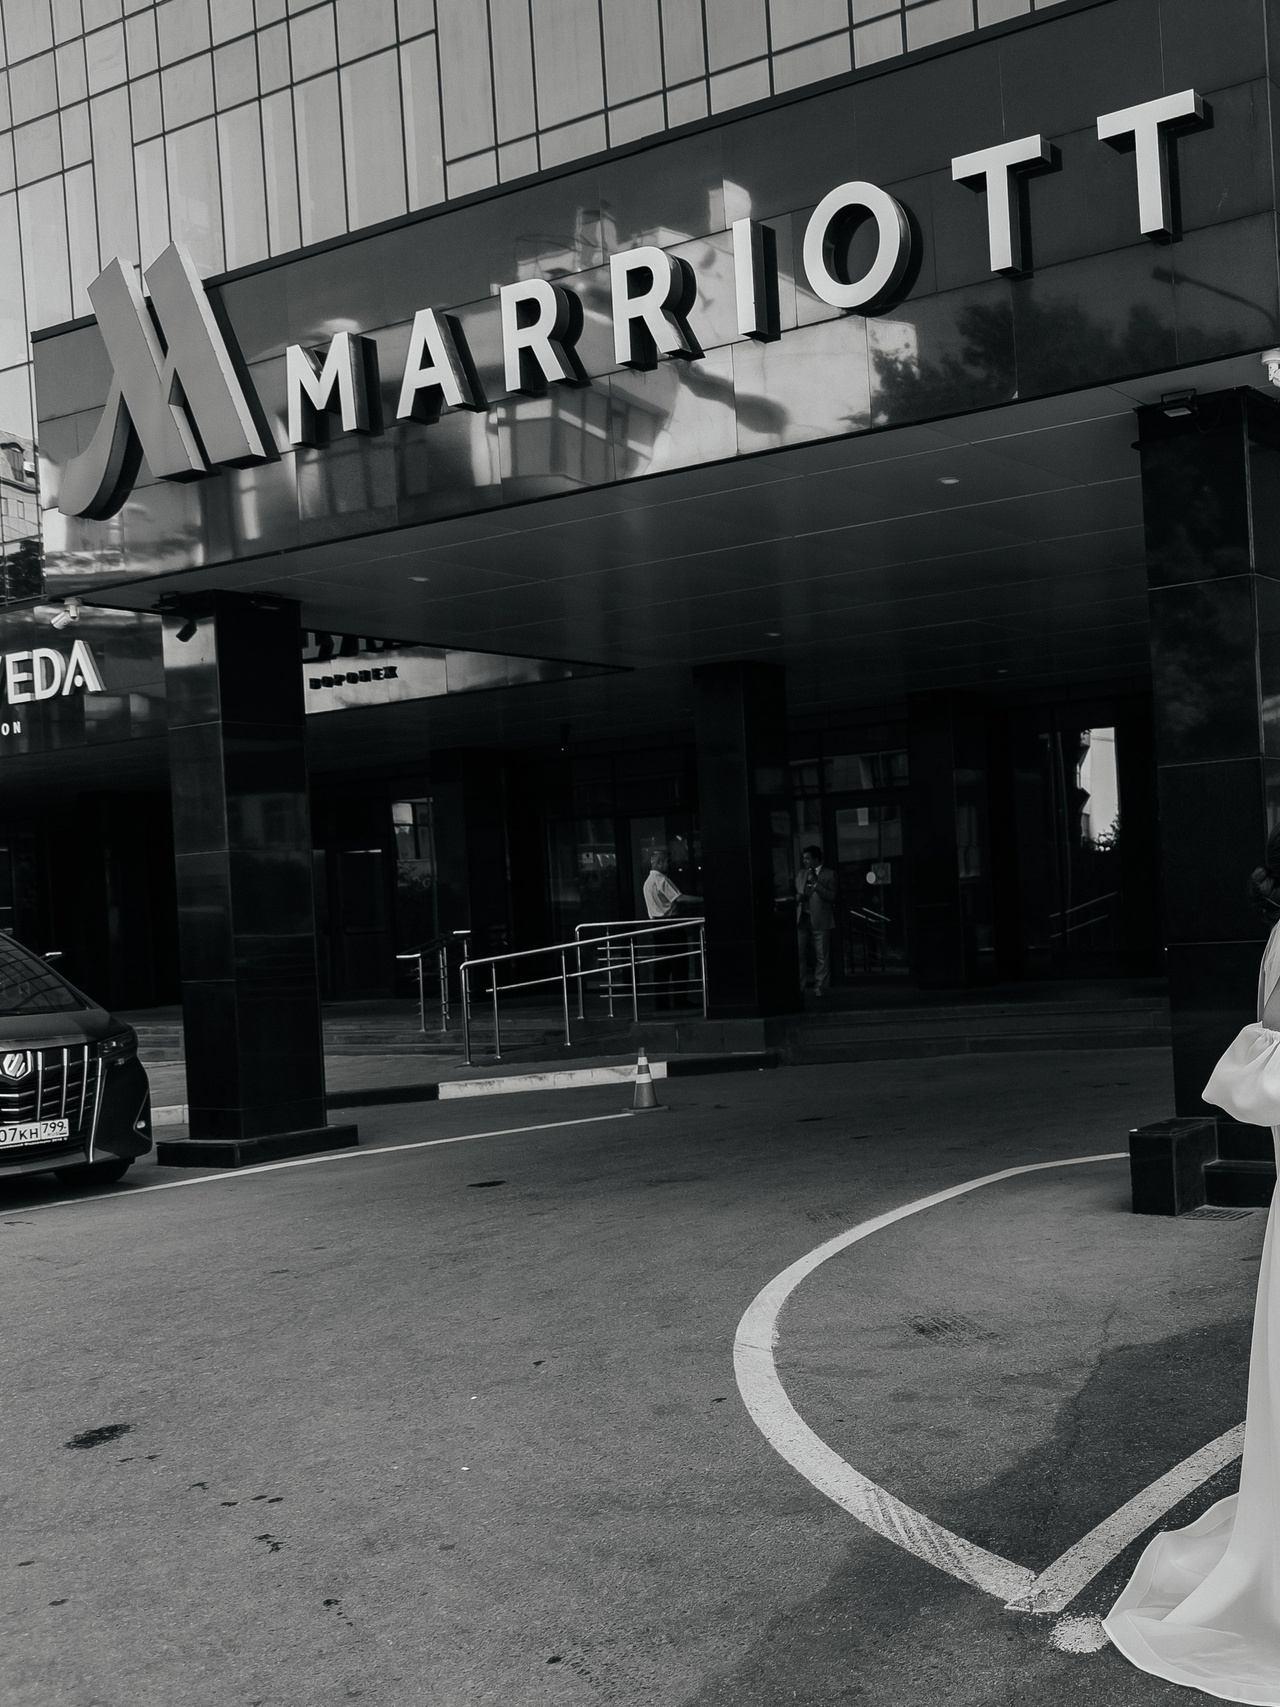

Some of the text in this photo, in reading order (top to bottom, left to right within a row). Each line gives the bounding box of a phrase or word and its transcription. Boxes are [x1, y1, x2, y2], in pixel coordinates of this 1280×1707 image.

[286, 89, 1206, 447] MARRIOTT
[0, 639, 105, 705] EDA
[41, 1121, 65, 1134] 799
